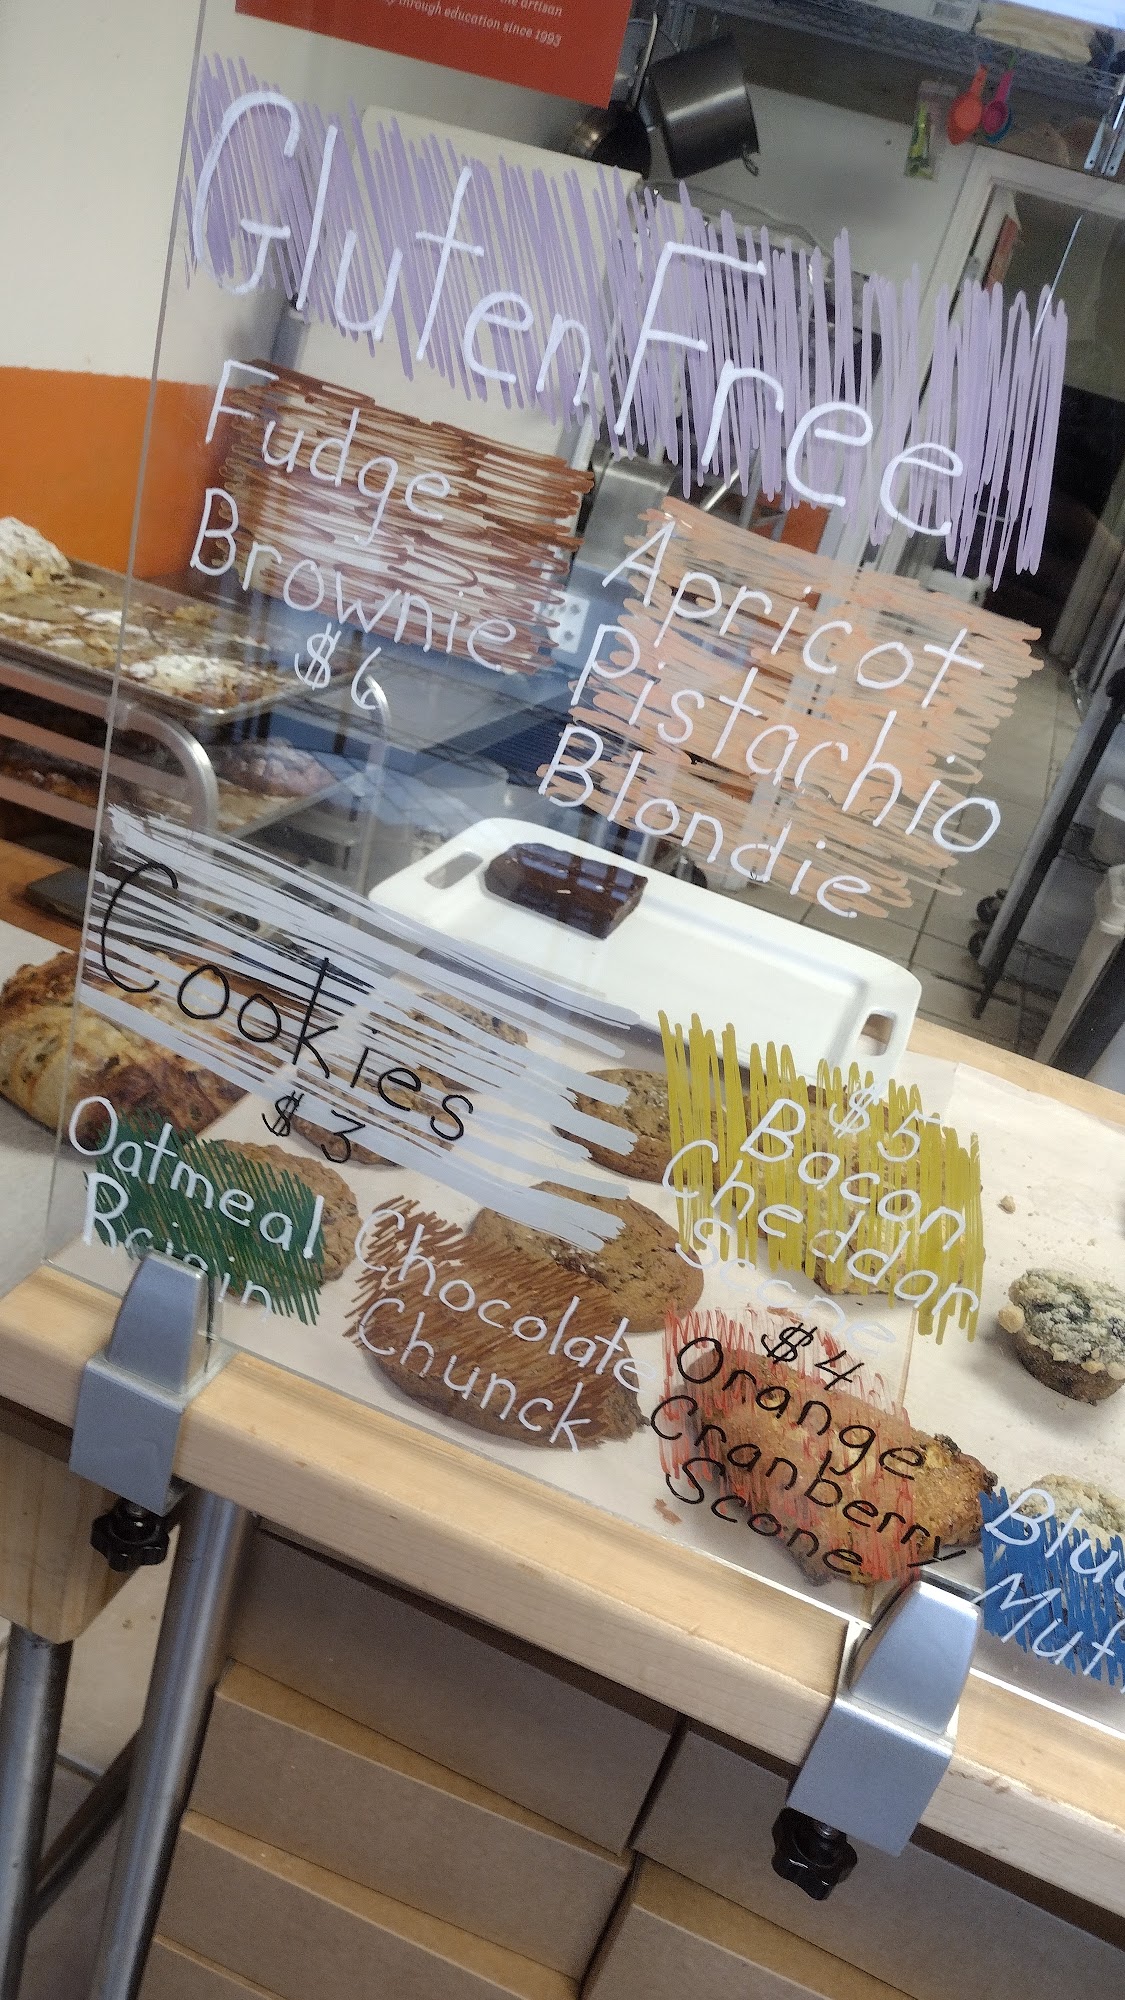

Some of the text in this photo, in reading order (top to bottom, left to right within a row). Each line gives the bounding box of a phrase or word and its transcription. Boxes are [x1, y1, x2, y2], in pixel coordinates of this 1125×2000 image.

[444, 6, 501, 30] education
[502, 21, 533, 39] since
[534, 29, 563, 48] 1993
[521, 0, 563, 17] artisan
[193, 91, 963, 536] Gluten Free
[206, 360, 450, 546] Fudge
[190, 488, 516, 671] Brownie
[602, 520, 984, 708] Apricot
[538, 726, 871, 919] Blondie
[571, 624, 1001, 852] Pistachio
[101, 862, 474, 1141] Cookies
[69, 1096, 325, 1259] Oatmeal
[662, 1139, 980, 1316] Cheddar
[740, 1098, 966, 1252] Bacon
[354, 1209, 658, 1394] Chocolate
[675, 1217, 896, 1355] Scone
[358, 1298, 592, 1453] Chunck
[677, 1337, 926, 1480] Orange
[650, 1395, 967, 1567] Cranberry
[666, 1457, 864, 1574] Scone
[971, 1573, 1125, 1693] Muf
